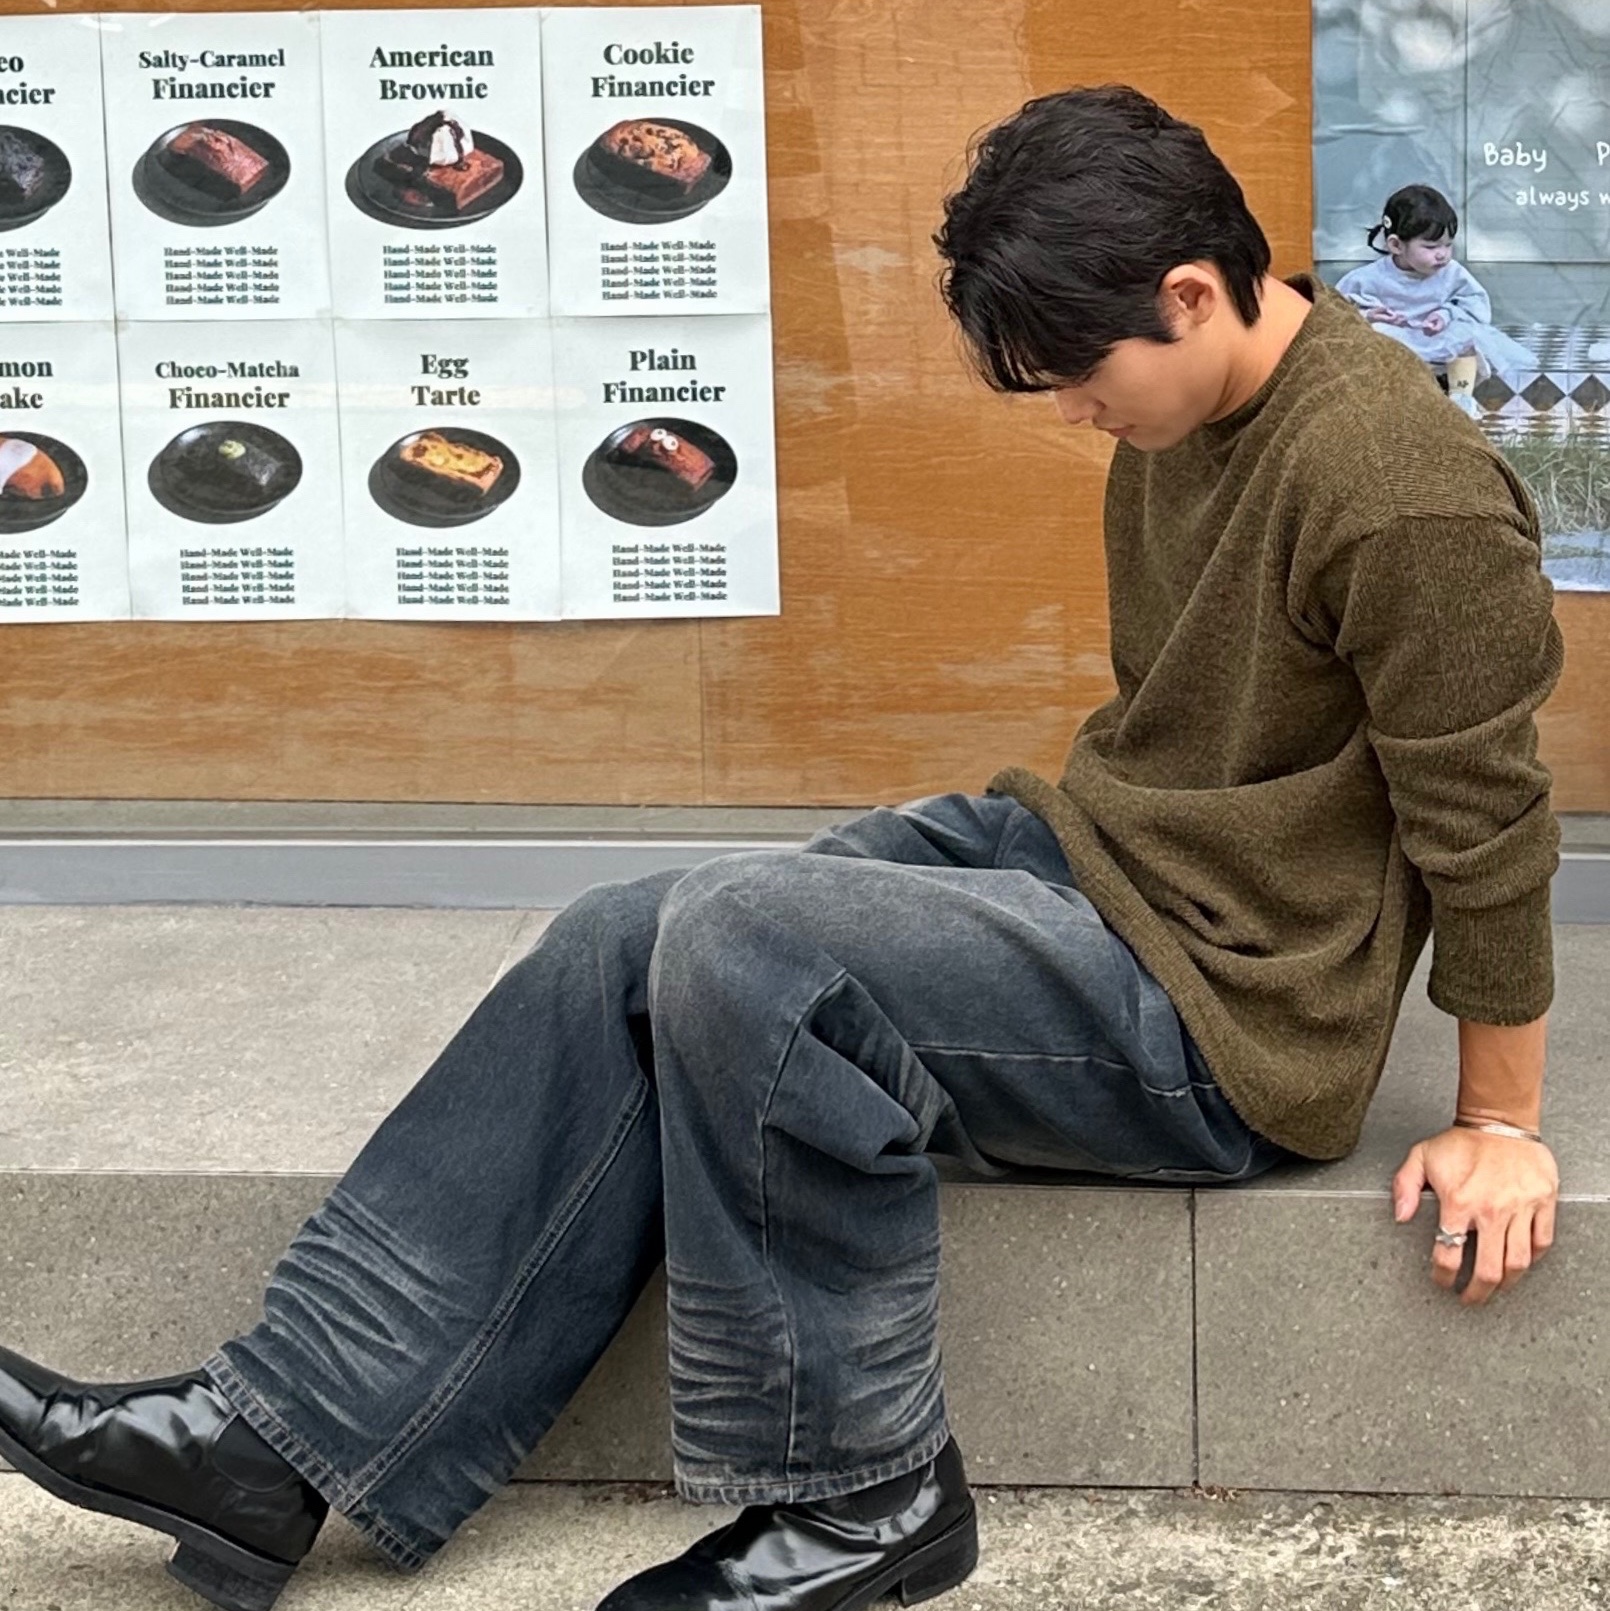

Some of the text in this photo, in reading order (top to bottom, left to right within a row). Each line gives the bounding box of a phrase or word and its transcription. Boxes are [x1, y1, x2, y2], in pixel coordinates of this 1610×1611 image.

[370, 44, 494, 67] American
[604, 41, 693, 65] Cookie
[139, 49, 285, 71] Salty-Caramel
[153, 76, 275, 99] Financier
[380, 77, 487, 99] Brownie
[592, 74, 715, 97] Financier
[1484, 142, 1547, 173] Baby
[1516, 186, 1590, 212] always
[383, 244, 496, 254] Hand-Made Well-Made
[601, 240, 716, 251] Hand-Made Well-Made
[6, 248, 60, 257] Well-Made
[164, 246, 278, 256] Hand-Made Well-Made
[165, 258, 278, 268] Hand-Made Well-Made
[384, 256, 497, 266] Hand-Made Well-Made
[601, 253, 716, 263] Hand-Made Well-Made
[7, 260, 60, 269] Well-Made
[384, 269, 497, 279] Hand-Made Well-Made
[602, 265, 716, 275] Hand-Made Well-Made
[7, 272, 61, 282] Well-Made
[165, 271, 279, 280] Hand-Made Well-Made
[384, 281, 497, 291] Hand-Made Well-Made
[602, 277, 717, 287] Hand-Made Well-Made
[8, 285, 62, 293] Well-Made
[166, 283, 279, 293] Hand-Made Well-Made
[166, 295, 279, 304] Hand-Made Well-Made
[385, 293, 498, 303] Hand-Made Well-Made
[602, 289, 717, 300] Hand-Made Well-Made
[8, 296, 62, 306] Well-Made
[630, 349, 696, 371] Plain
[155, 361, 299, 378] Choco-Matcha
[421, 355, 469, 378] Egg
[411, 386, 480, 405] Tarte
[603, 380, 726, 403] Financier
[169, 386, 290, 408] Financier
[180, 547, 293, 558] Hand-Made Well-Made
[396, 547, 508, 556] Hand-Made Well-Made
[612, 543, 726, 553] Hand-Made Well-Made
[23, 549, 76, 558] Well-Made
[24, 561, 77, 570] Well-Made
[180, 559, 294, 570] Hand-Made Well-Made
[397, 559, 509, 568] Hand-Made Well-Made
[613, 555, 726, 566] Hand-Made Well-Made
[24, 573, 78, 582] Well-Made
[181, 571, 294, 581] Hand-Made Well-Made
[397, 571, 509, 580] Hand-Made Well-Made
[613, 568, 727, 577] Hand-Made Well-Made
[25, 585, 79, 594] Well-Made
[182, 583, 294, 593] Hand-Made Well-Made
[398, 583, 509, 593] Hand-Made Well-Made
[613, 579, 727, 590] Hand-Made Well-Made
[25, 597, 79, 606] Well-Made
[183, 595, 295, 605] Hand-Made Well-Made
[398, 595, 510, 604] Hand-Made Well-Made
[613, 591, 727, 602] Hand-Made Well-Made
